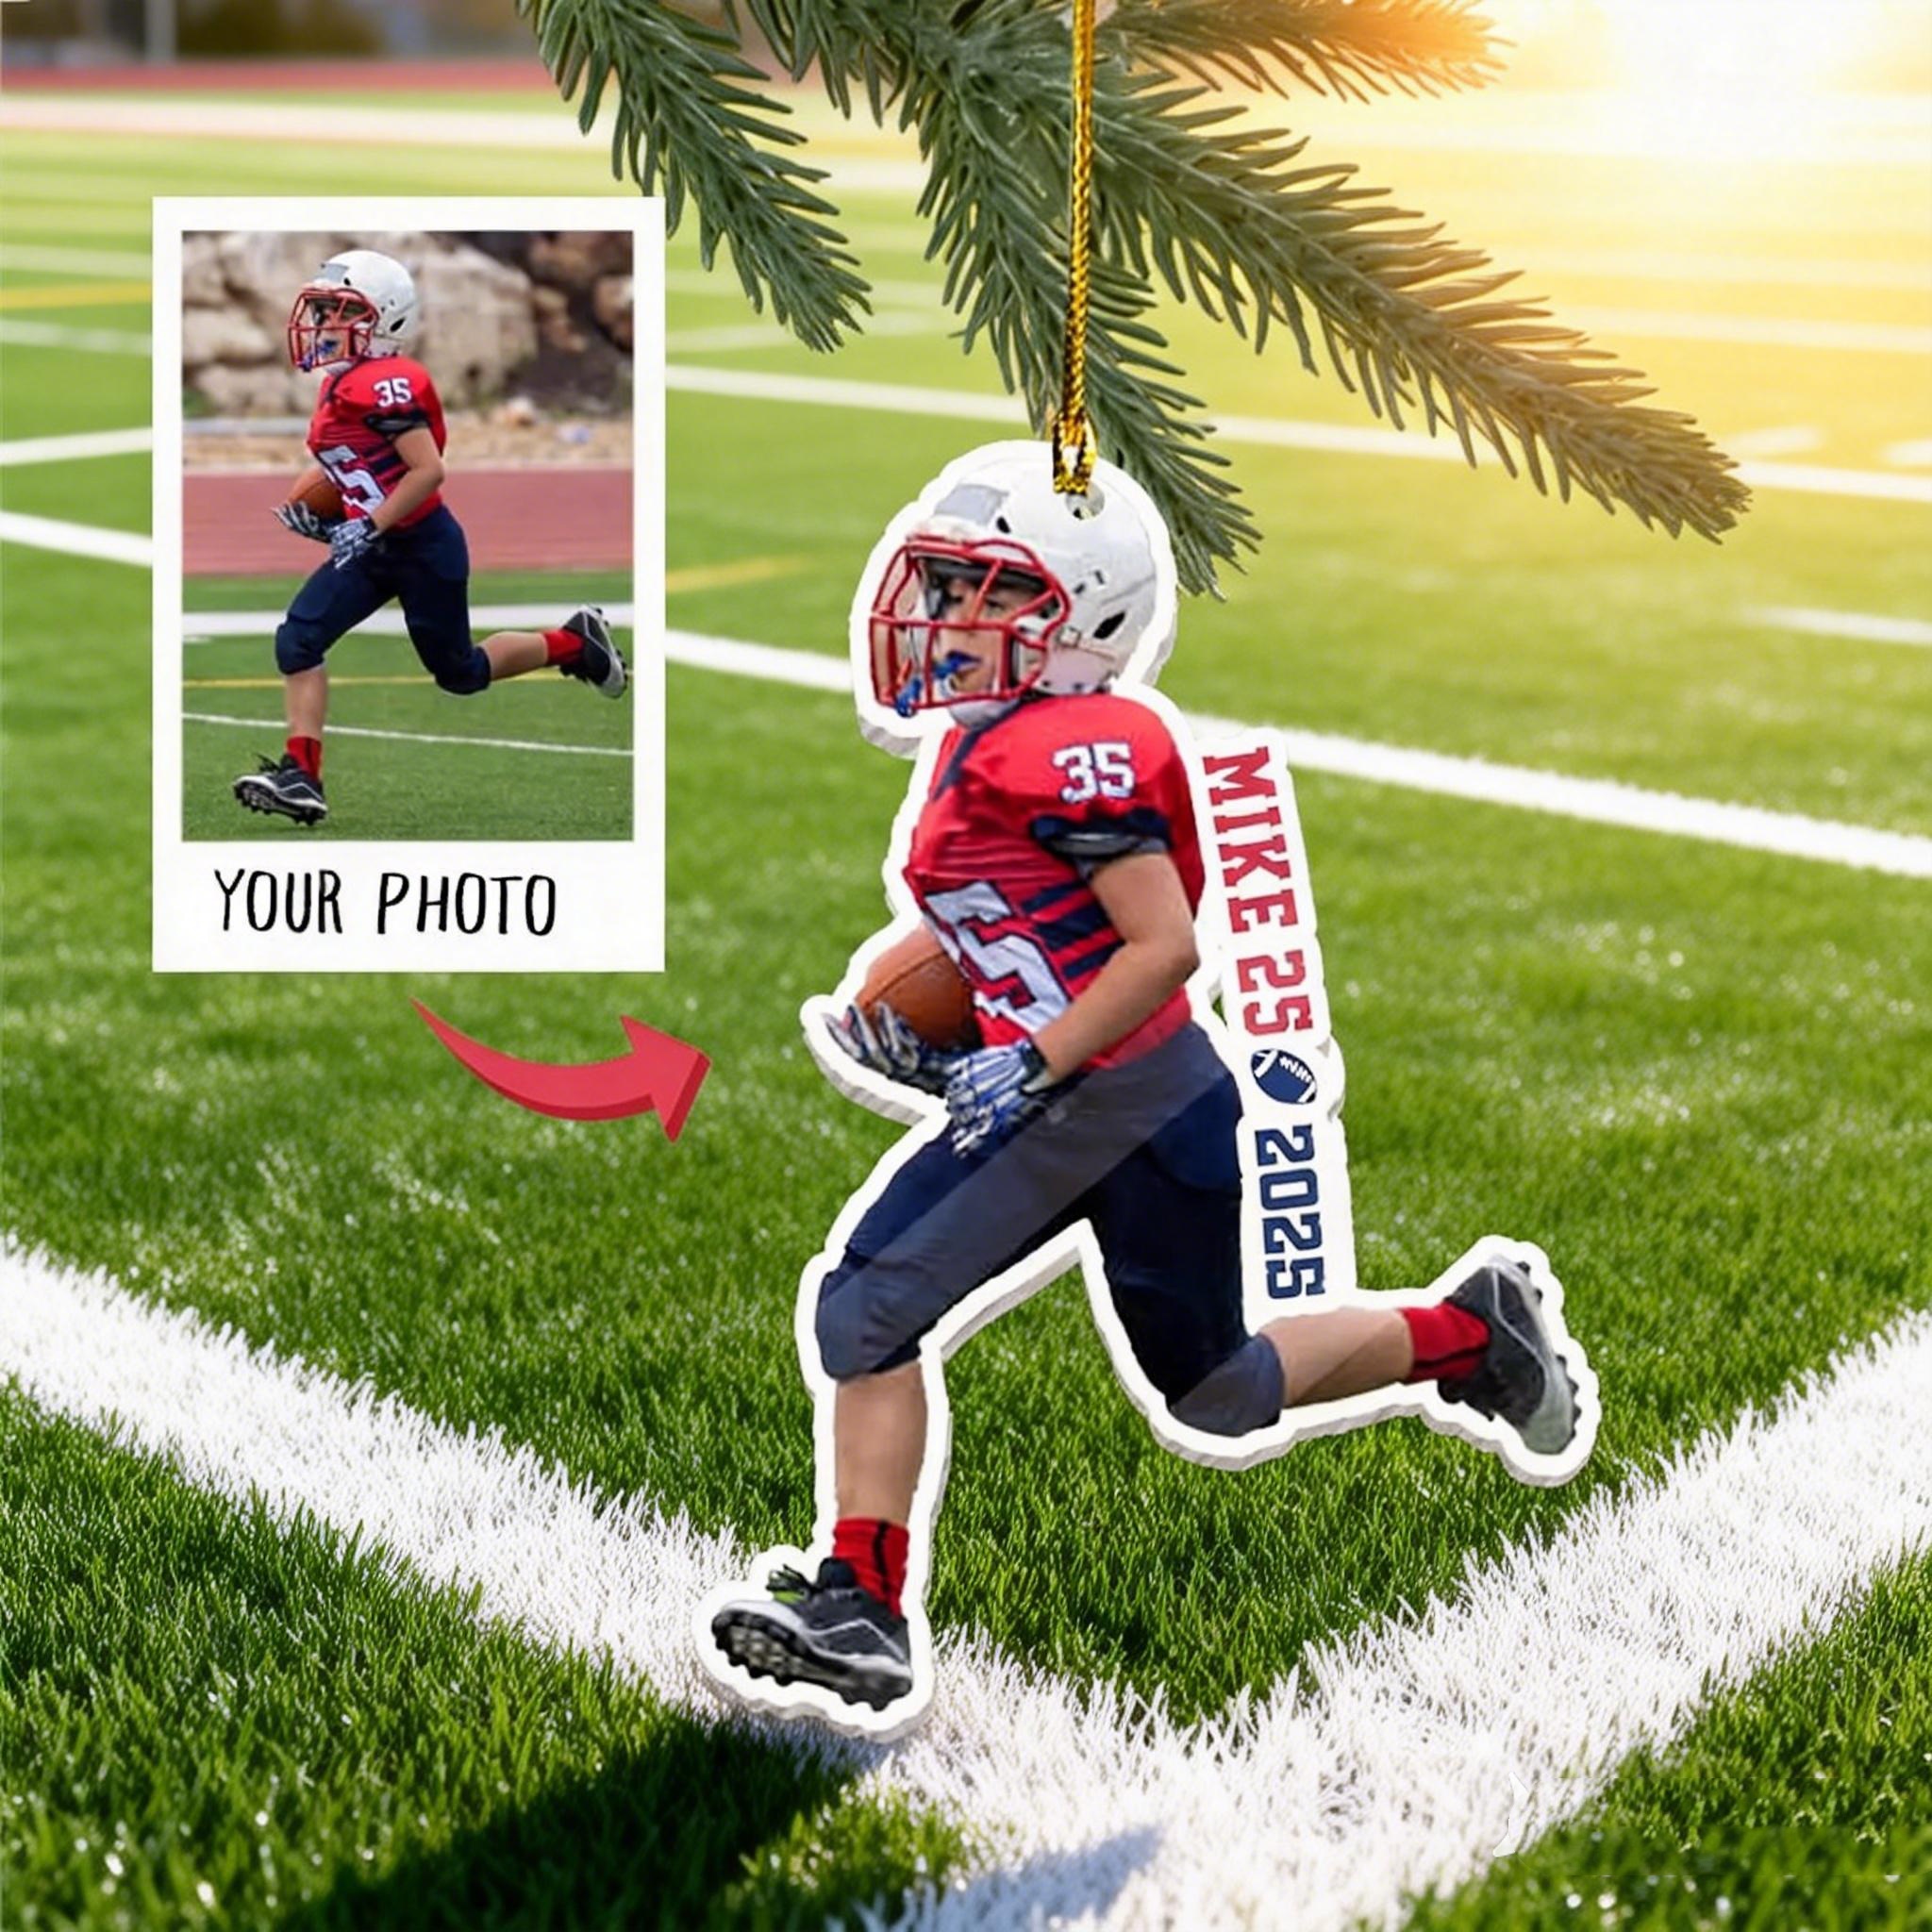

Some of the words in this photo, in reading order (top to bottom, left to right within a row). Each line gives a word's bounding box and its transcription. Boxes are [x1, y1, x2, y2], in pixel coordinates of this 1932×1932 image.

[374, 377, 412, 408] 35
[1053, 742, 1135, 803] 35
[1203, 746, 1298, 934] MIKE
[1237, 949, 1313, 1036] 25
[1255, 1124, 1325, 1300] 2025
